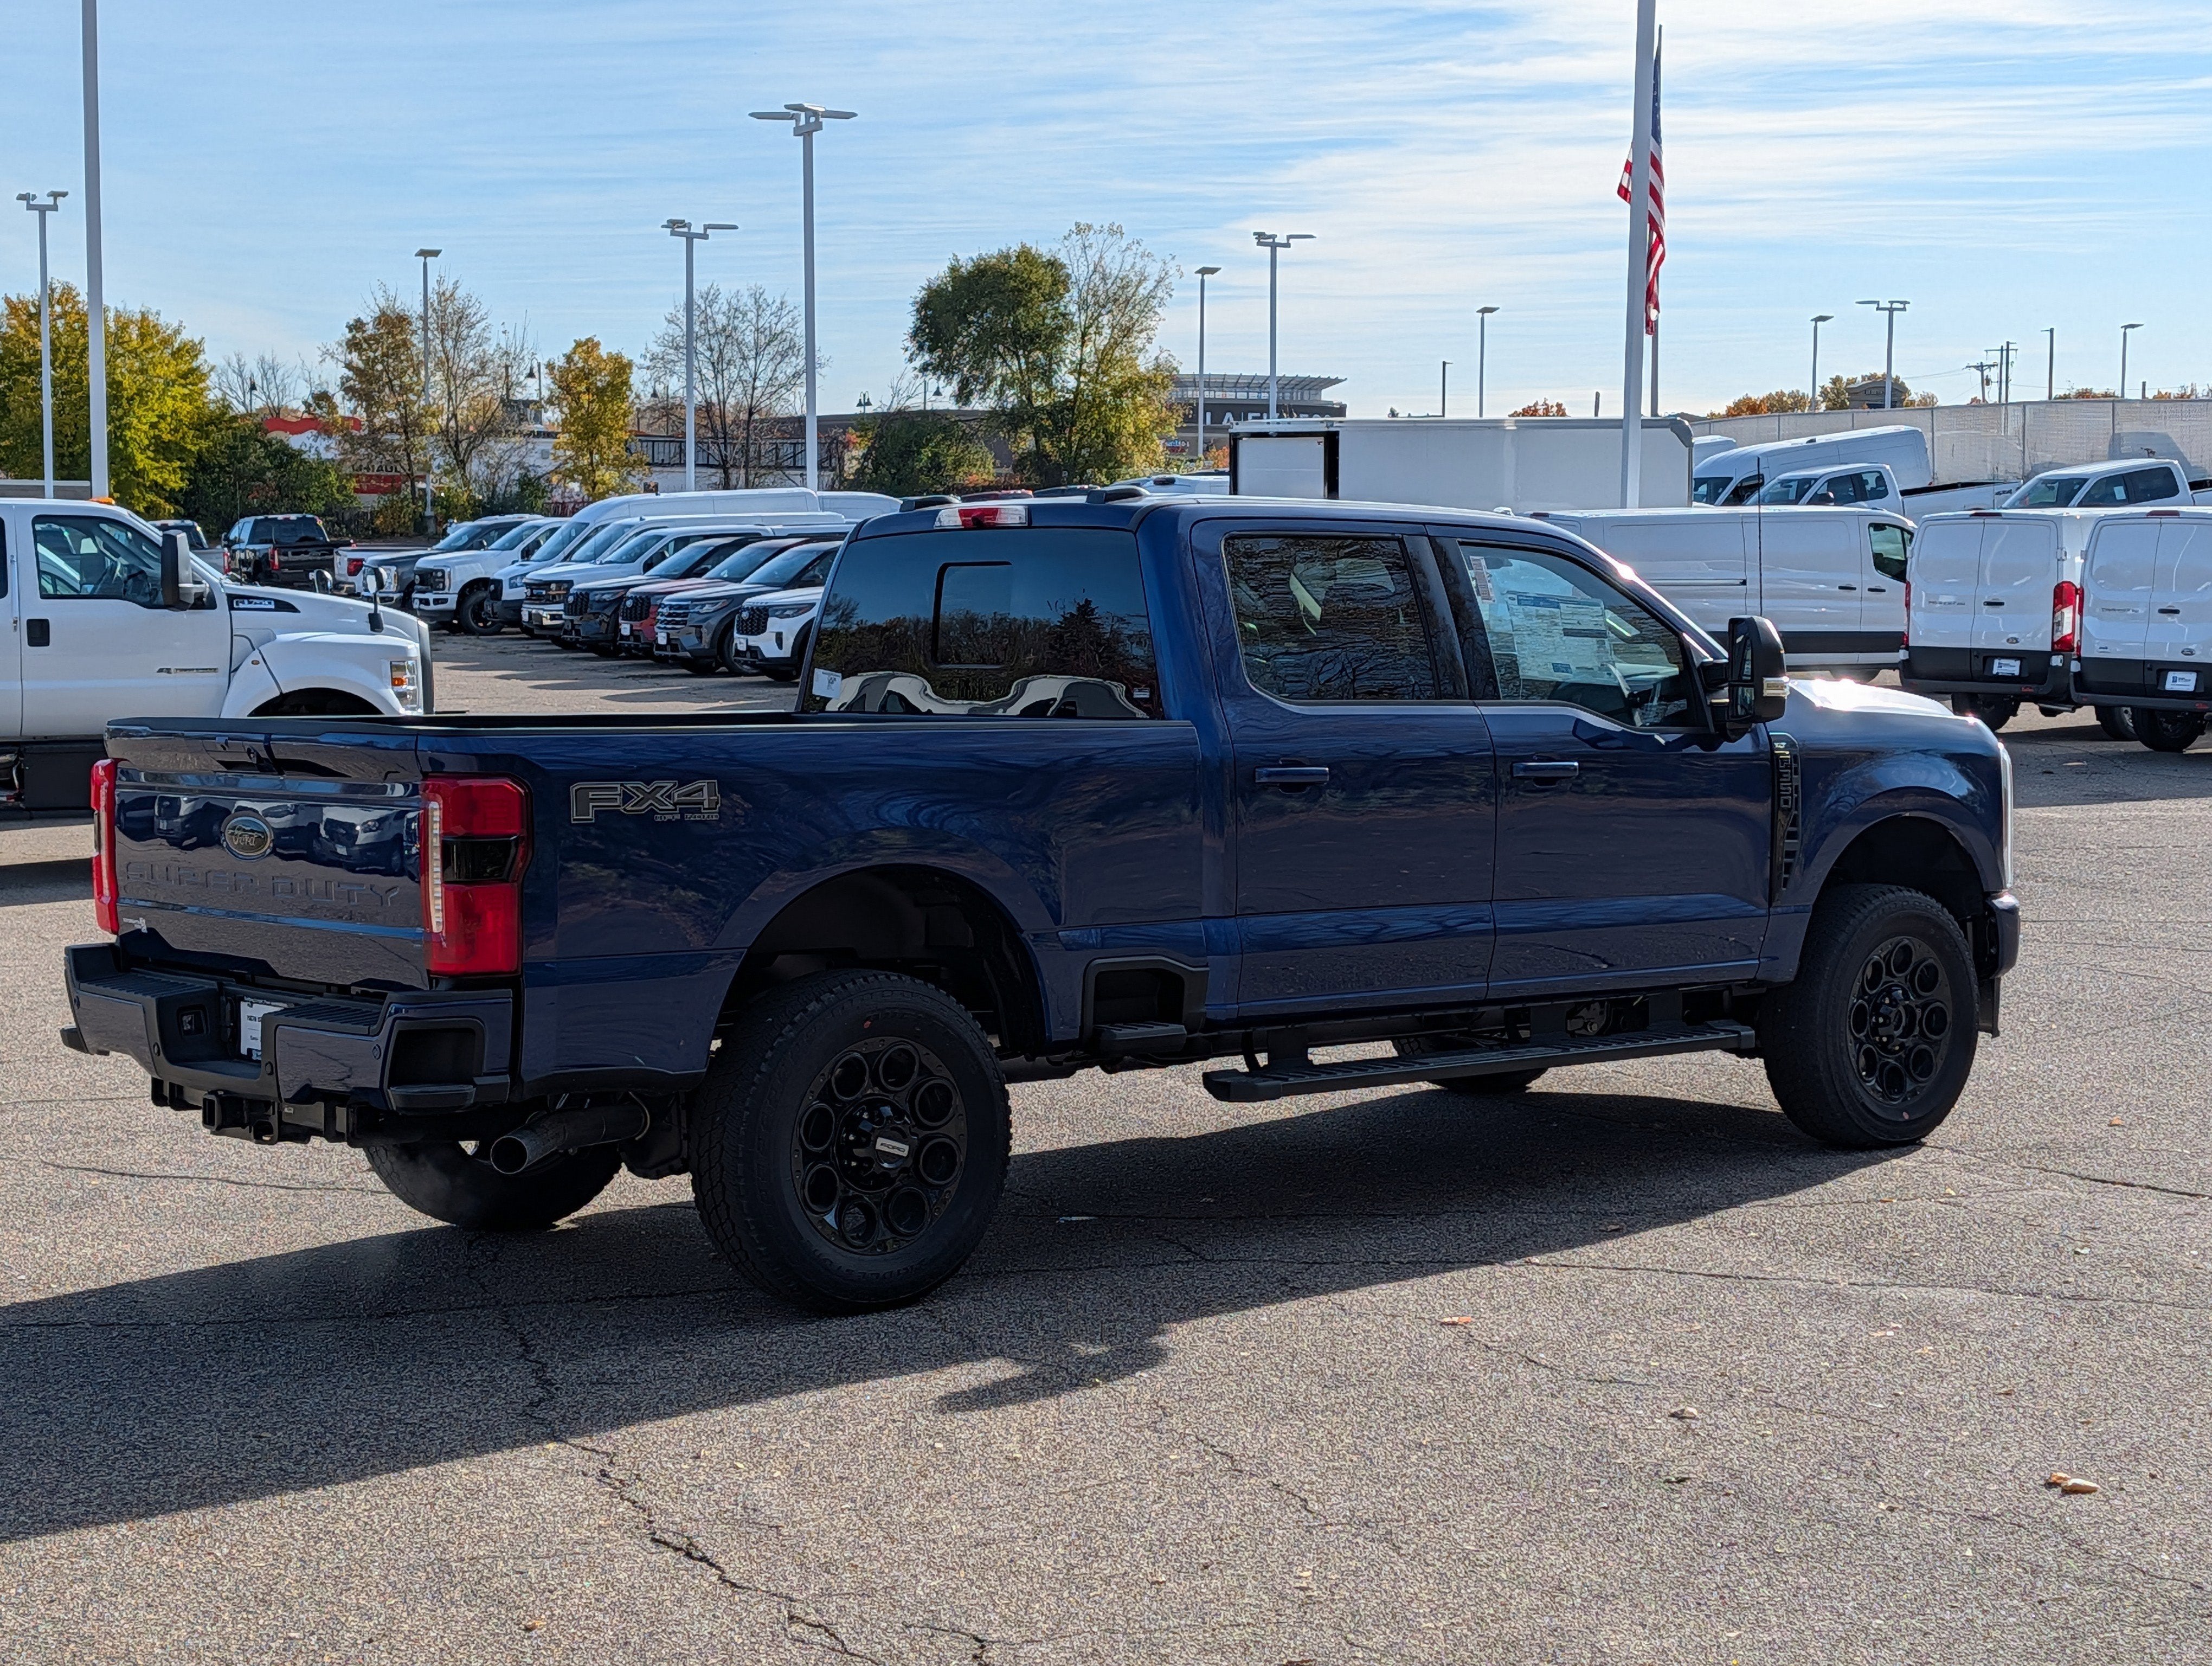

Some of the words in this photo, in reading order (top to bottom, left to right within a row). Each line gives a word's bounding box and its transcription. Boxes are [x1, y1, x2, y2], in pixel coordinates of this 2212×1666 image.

[570, 780, 721, 823] FX4
[125, 861, 260, 895] SUPER
[271, 875, 401, 907] DUTY
[880, 1142, 905, 1153] FORD
